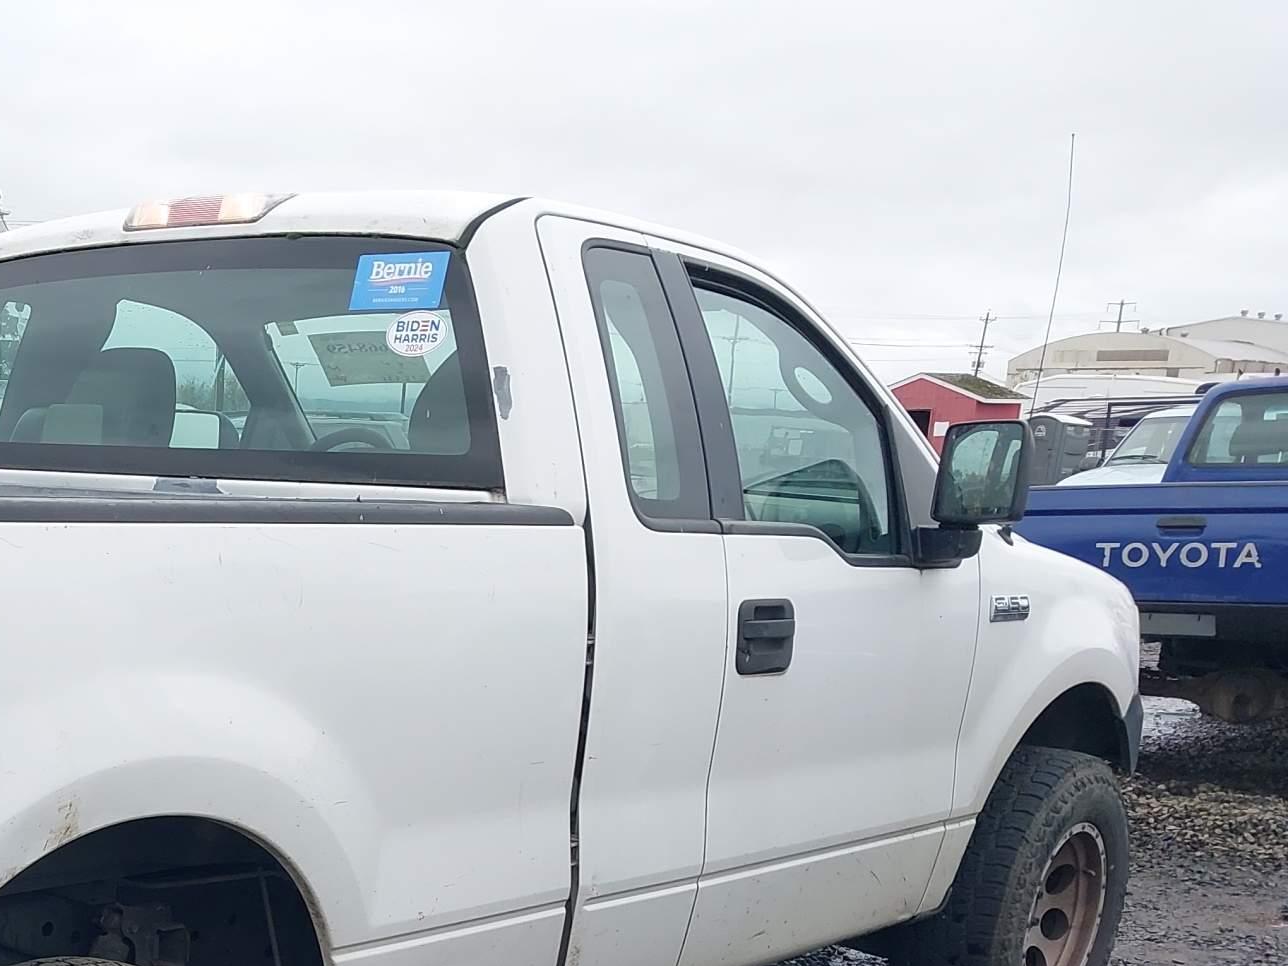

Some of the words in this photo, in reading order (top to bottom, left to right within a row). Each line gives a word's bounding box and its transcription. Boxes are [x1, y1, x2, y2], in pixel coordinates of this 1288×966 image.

[369, 257, 433, 279] Bernie
[396, 320, 441, 332] BIDEN
[394, 333, 438, 343] HARRIS
[405, 344, 424, 352] 2024
[1095, 542, 1262, 569] TOYOTA
